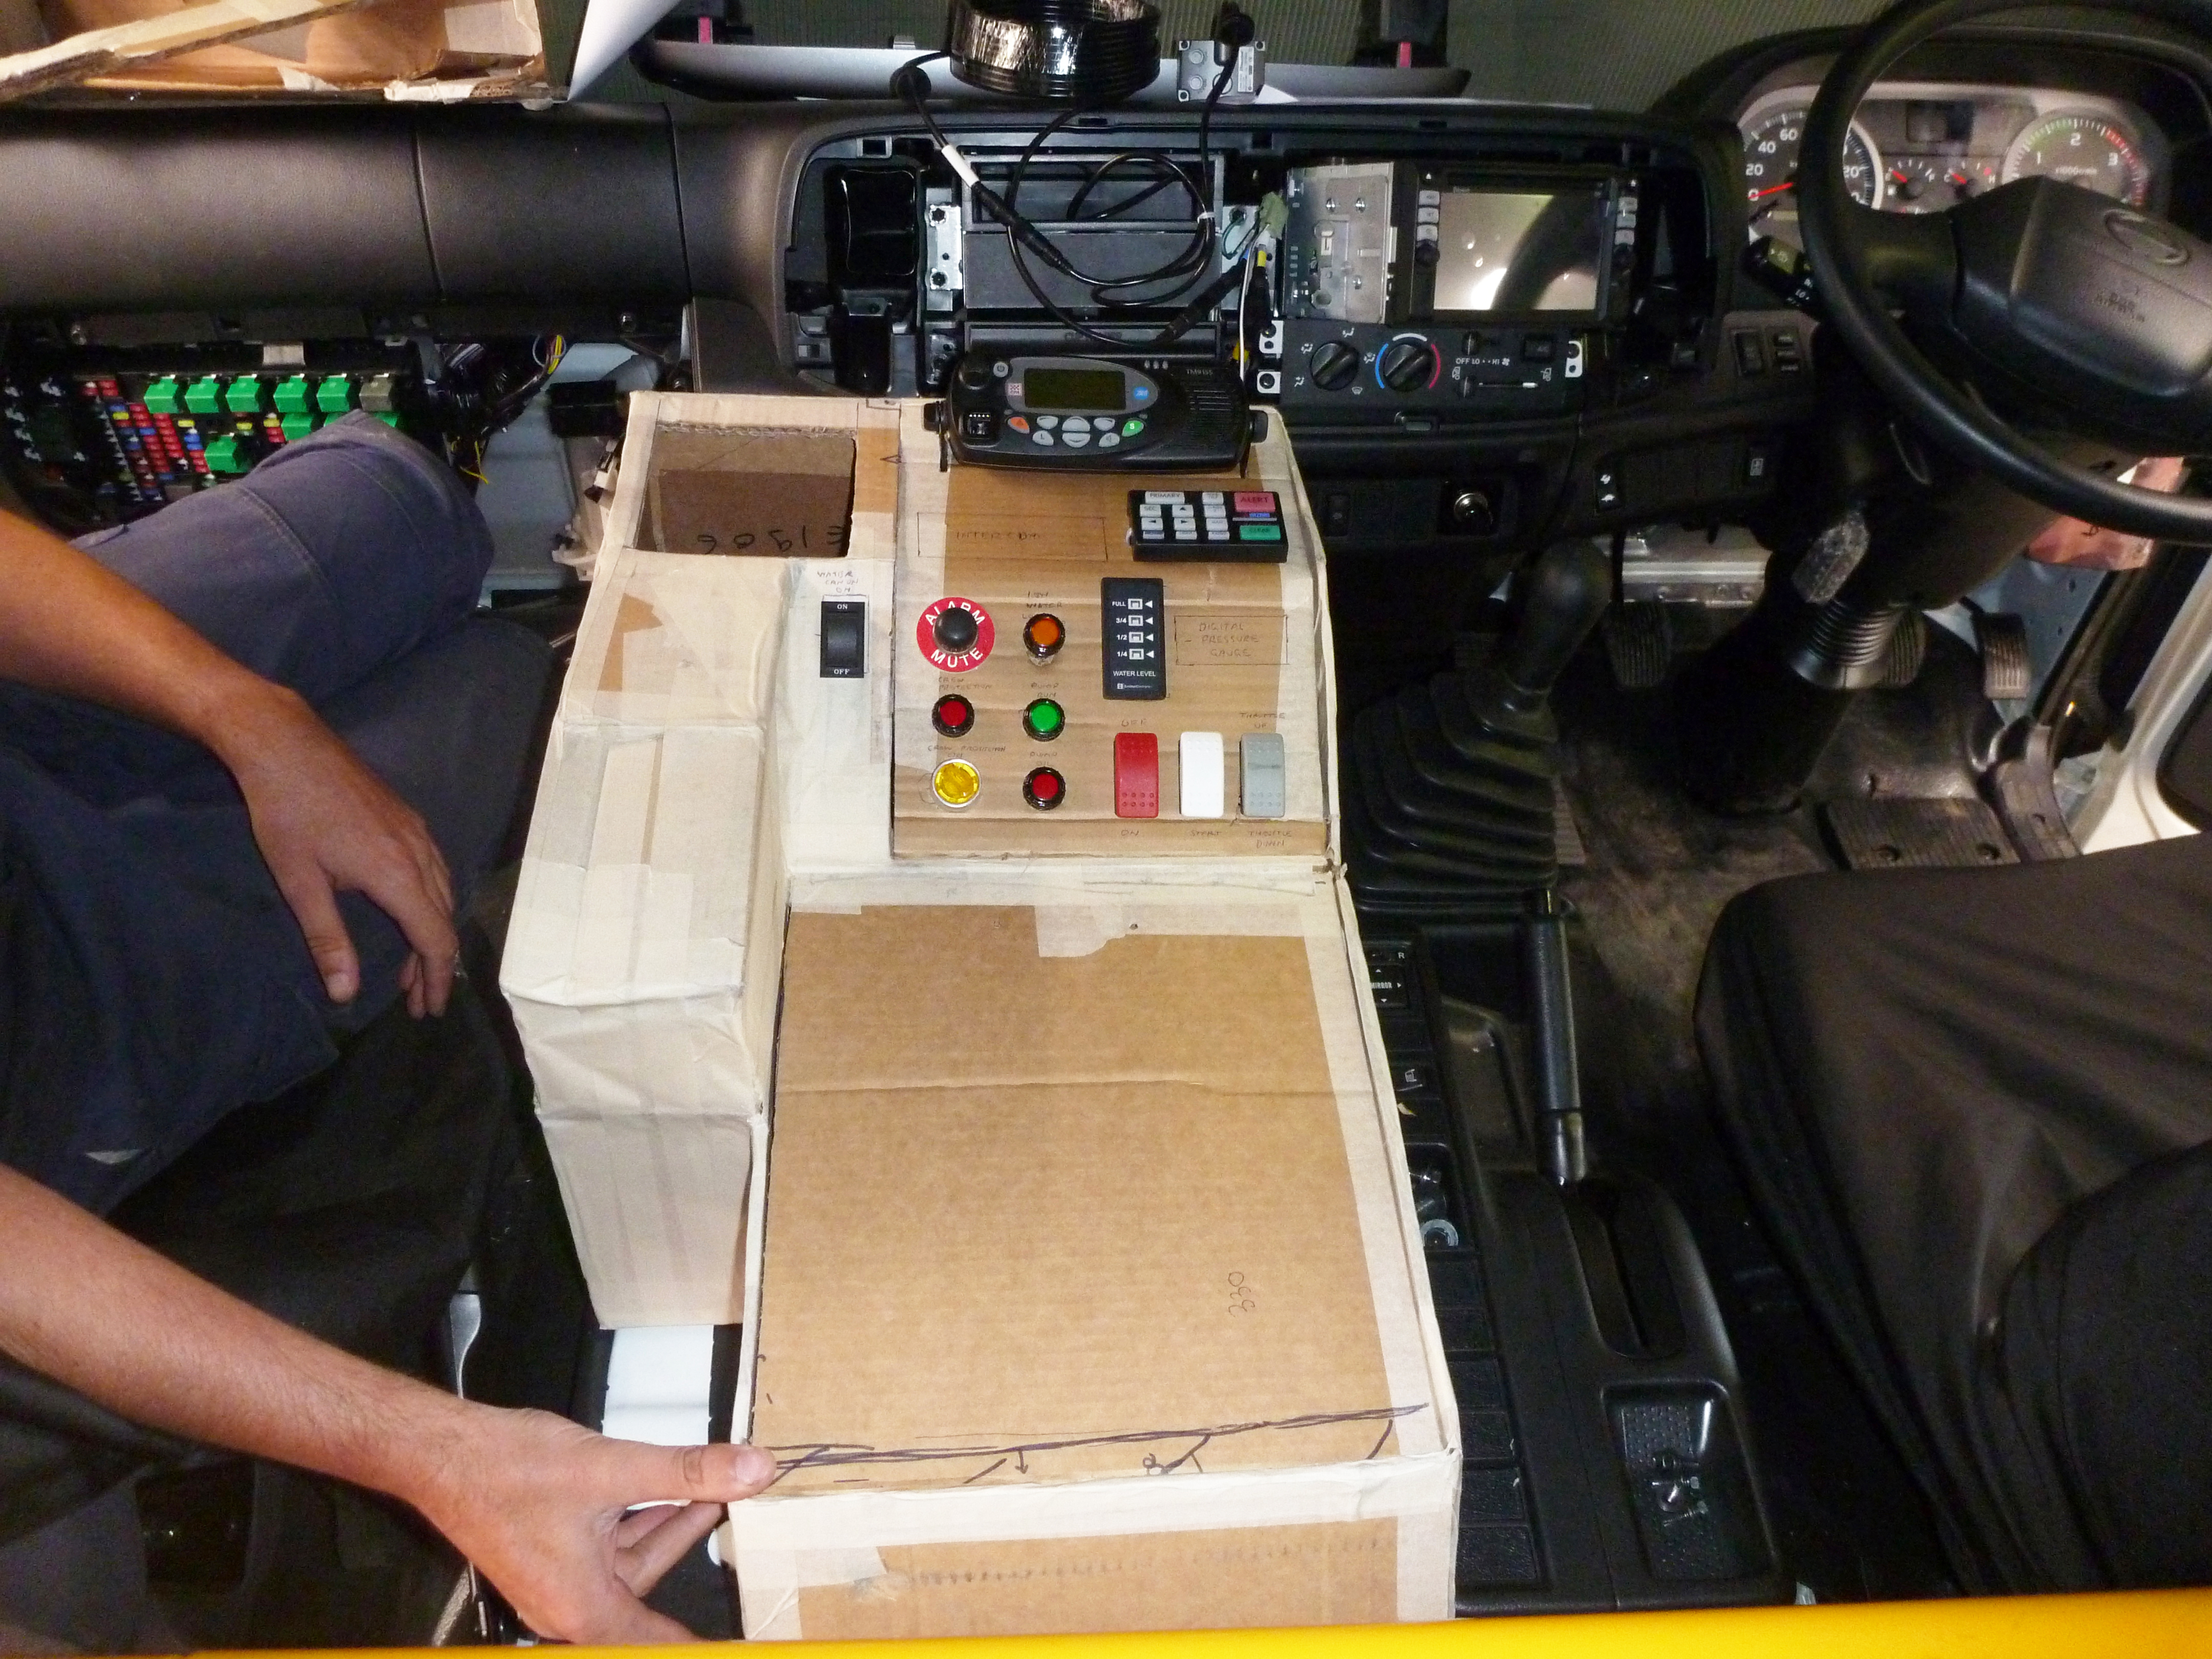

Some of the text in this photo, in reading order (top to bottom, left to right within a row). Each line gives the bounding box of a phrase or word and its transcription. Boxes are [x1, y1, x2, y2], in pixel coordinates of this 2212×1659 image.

[1780, 129, 1798, 141] 60
[2070, 132, 2081, 146] 2
[1758, 141, 1776, 154] 40
[2036, 151, 2041, 164] 1
[1746, 163, 1763, 176] 20
[1843, 165, 1859, 178] 20
[925, 601, 985, 625] ALARM
[1199, 623, 1244, 632] DIGITAL
[1201, 634, 1259, 643] PRESSURE
[930, 648, 983, 668] MUTE
[1210, 649, 1251, 657] GAUGE
[1121, 718, 1147, 727] OFF
